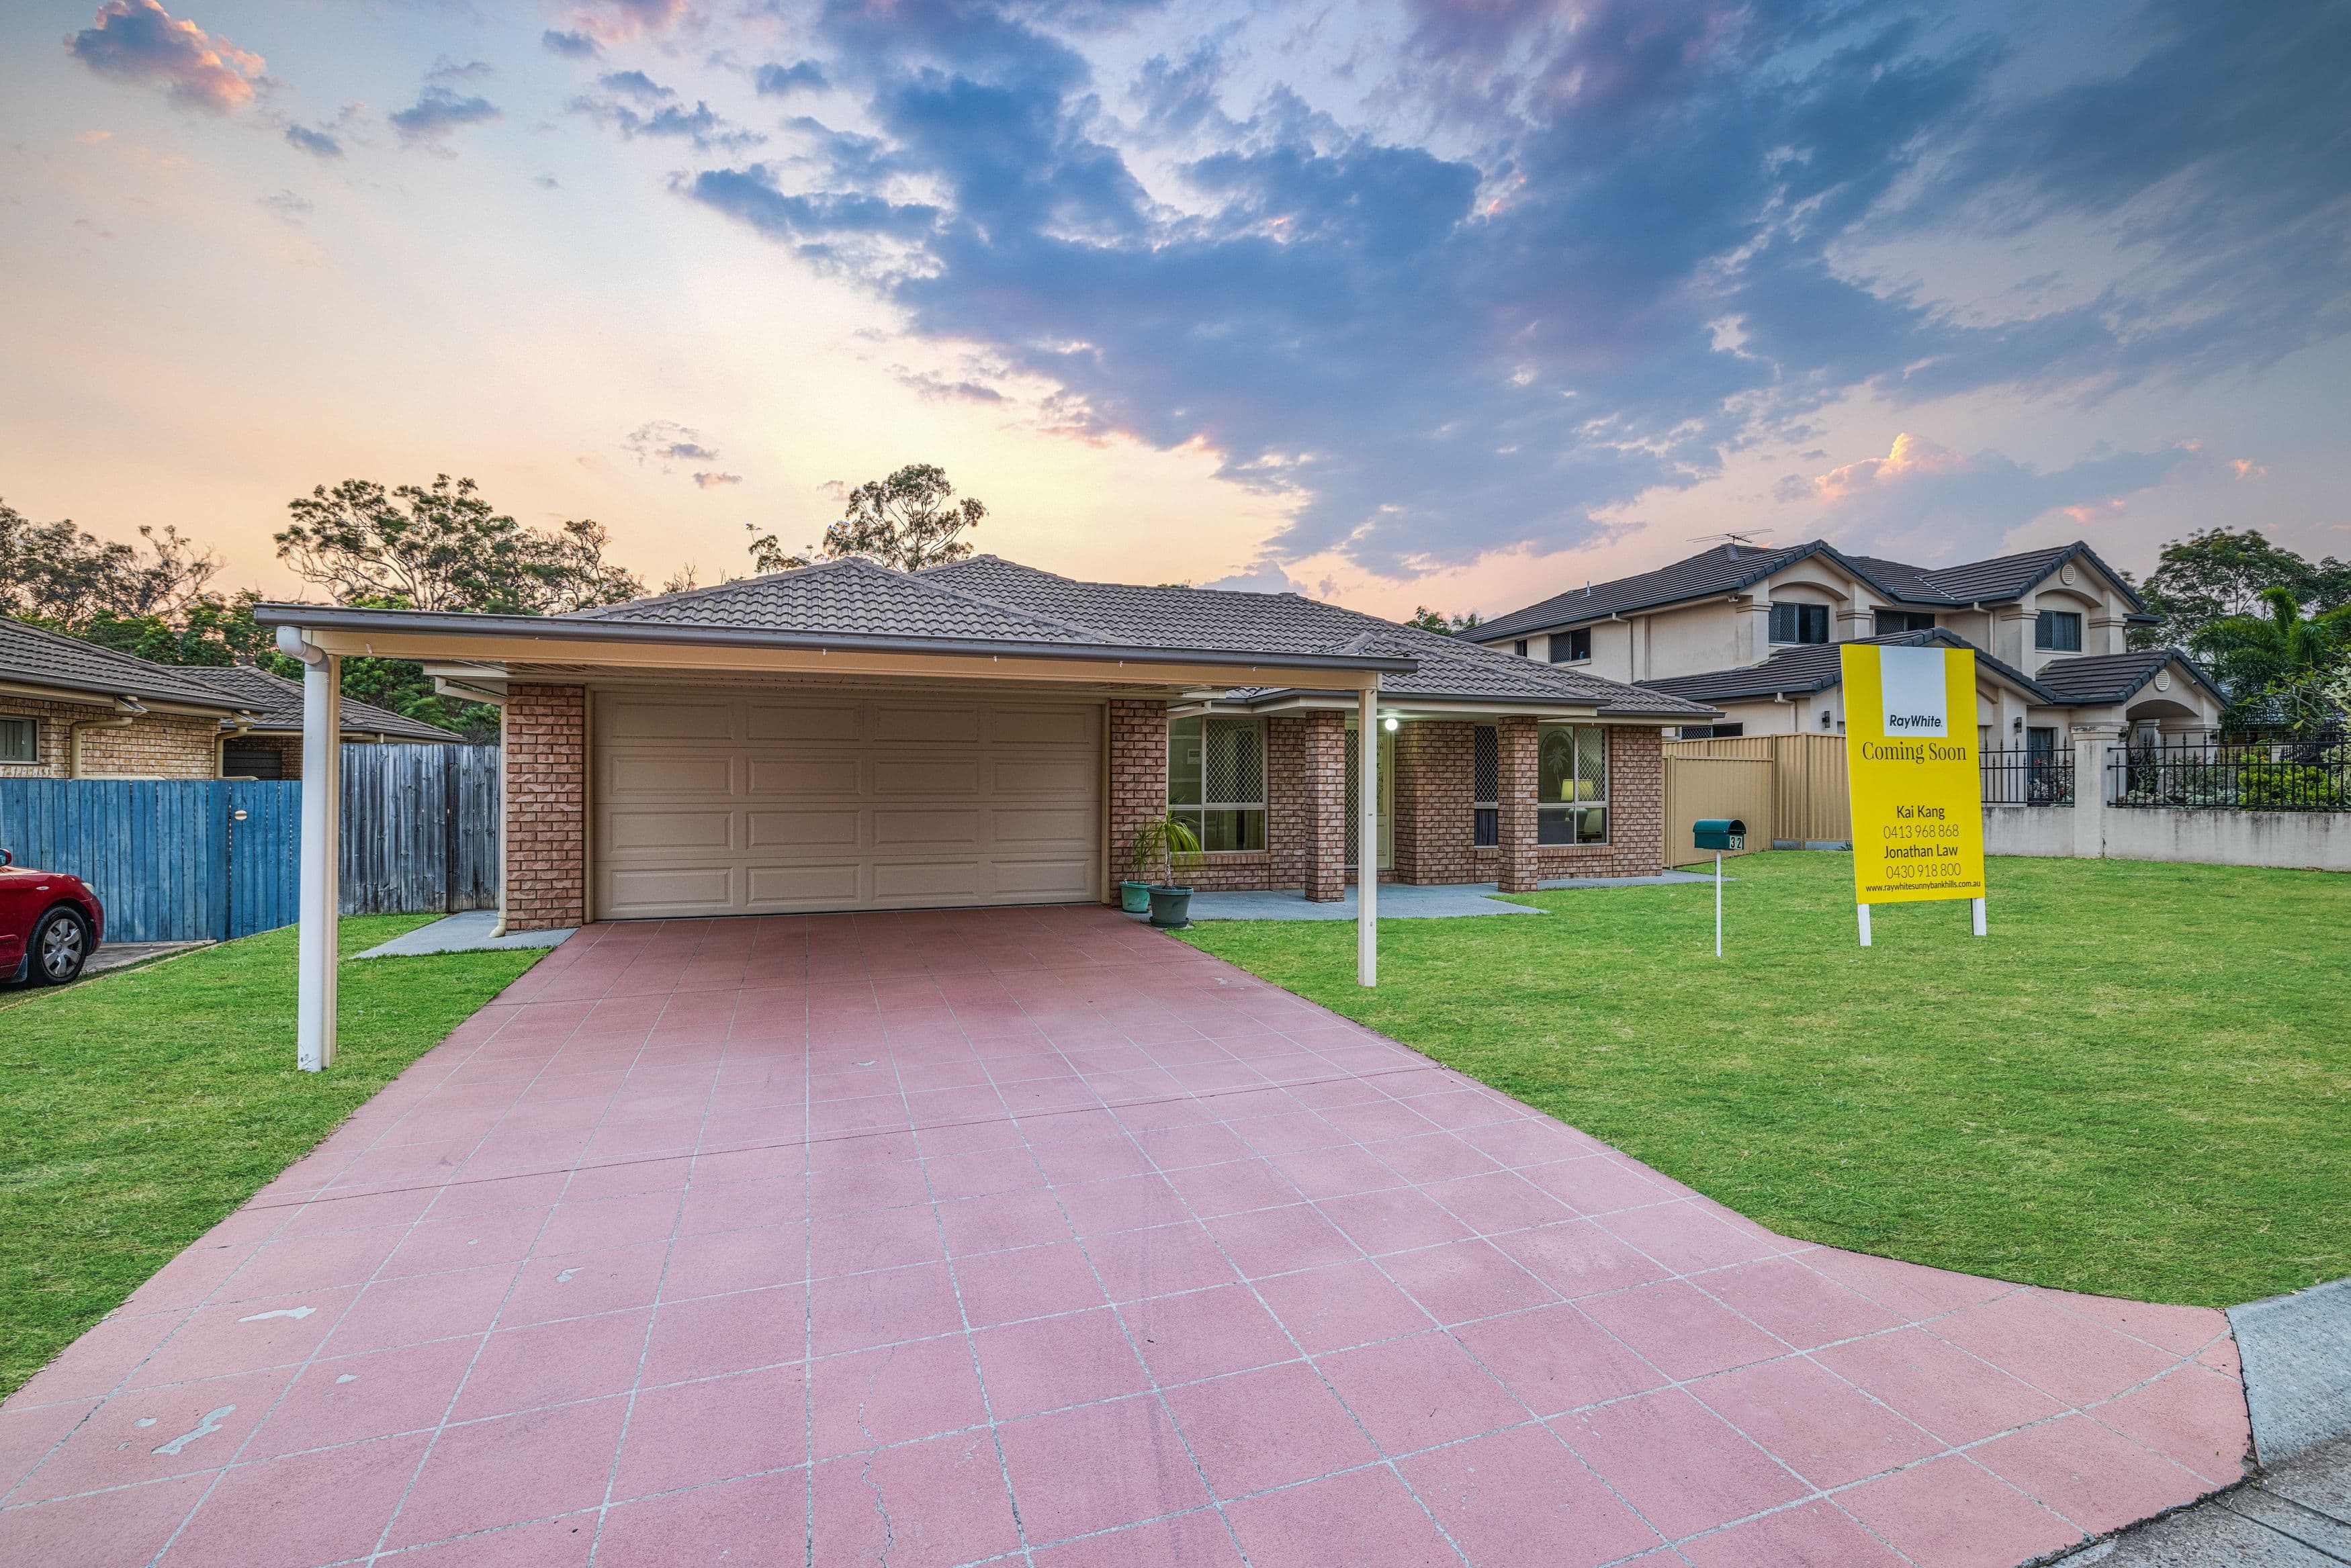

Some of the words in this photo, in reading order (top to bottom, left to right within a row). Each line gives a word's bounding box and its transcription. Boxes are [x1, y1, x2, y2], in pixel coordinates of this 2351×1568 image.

[1863, 741, 1924, 764] Coming
[1928, 742, 1967, 761] Soon
[1897, 805, 1914, 819] Kai
[1918, 805, 1945, 820] Kang
[1883, 825, 1912, 839] 0413
[1915, 825, 1936, 837] 968
[1938, 824, 1959, 837] 868
[1730, 837, 1741, 849] 32
[1883, 845, 1933, 858] Jonathan
[1937, 844, 1958, 857] Law
[1886, 865, 1914, 879] 0430
[1918, 864, 1938, 877] 918
[1941, 863, 1961, 876] 800
[1865, 880, 1981, 892] www.raywhitesunnybankhills.com.au
